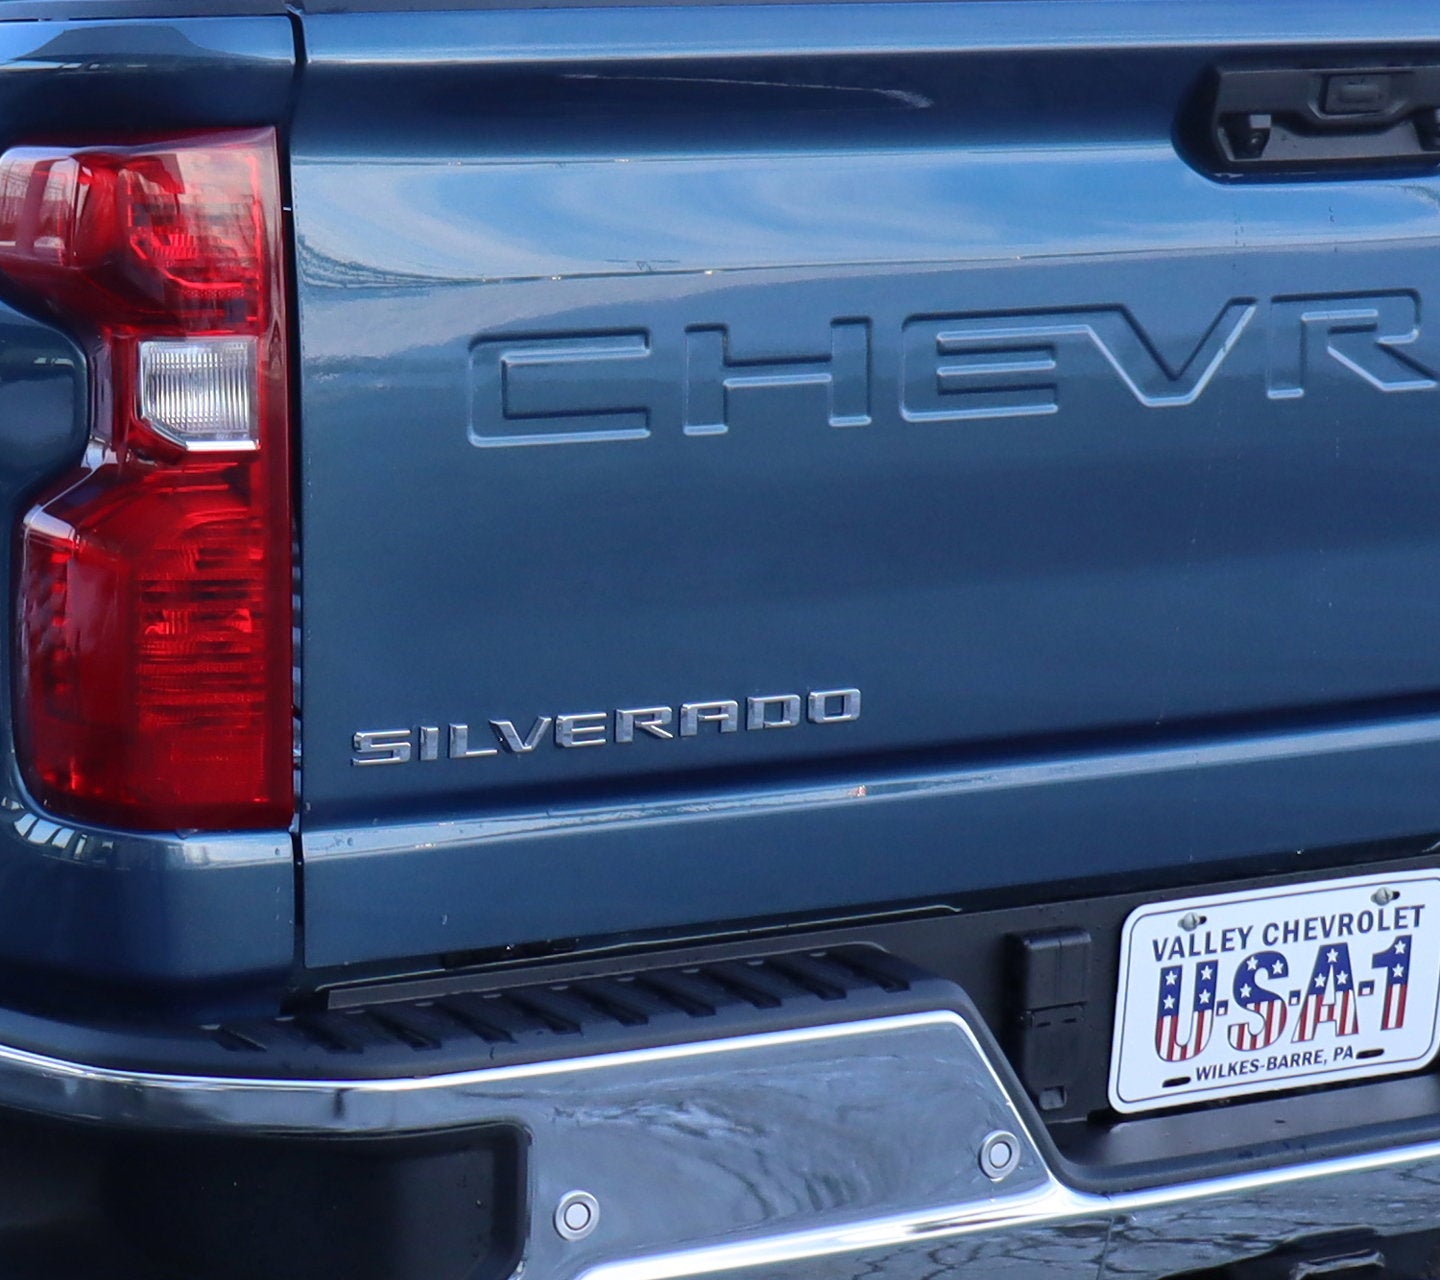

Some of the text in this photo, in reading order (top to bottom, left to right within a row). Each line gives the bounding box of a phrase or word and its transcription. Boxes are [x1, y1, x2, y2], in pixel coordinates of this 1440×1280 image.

[351, 688, 862, 767] SILVERADO
[1151, 904, 1426, 962] VALLEY CHEVROLET
[1195, 1045, 1355, 1082] WILKES-BARRE, PA
